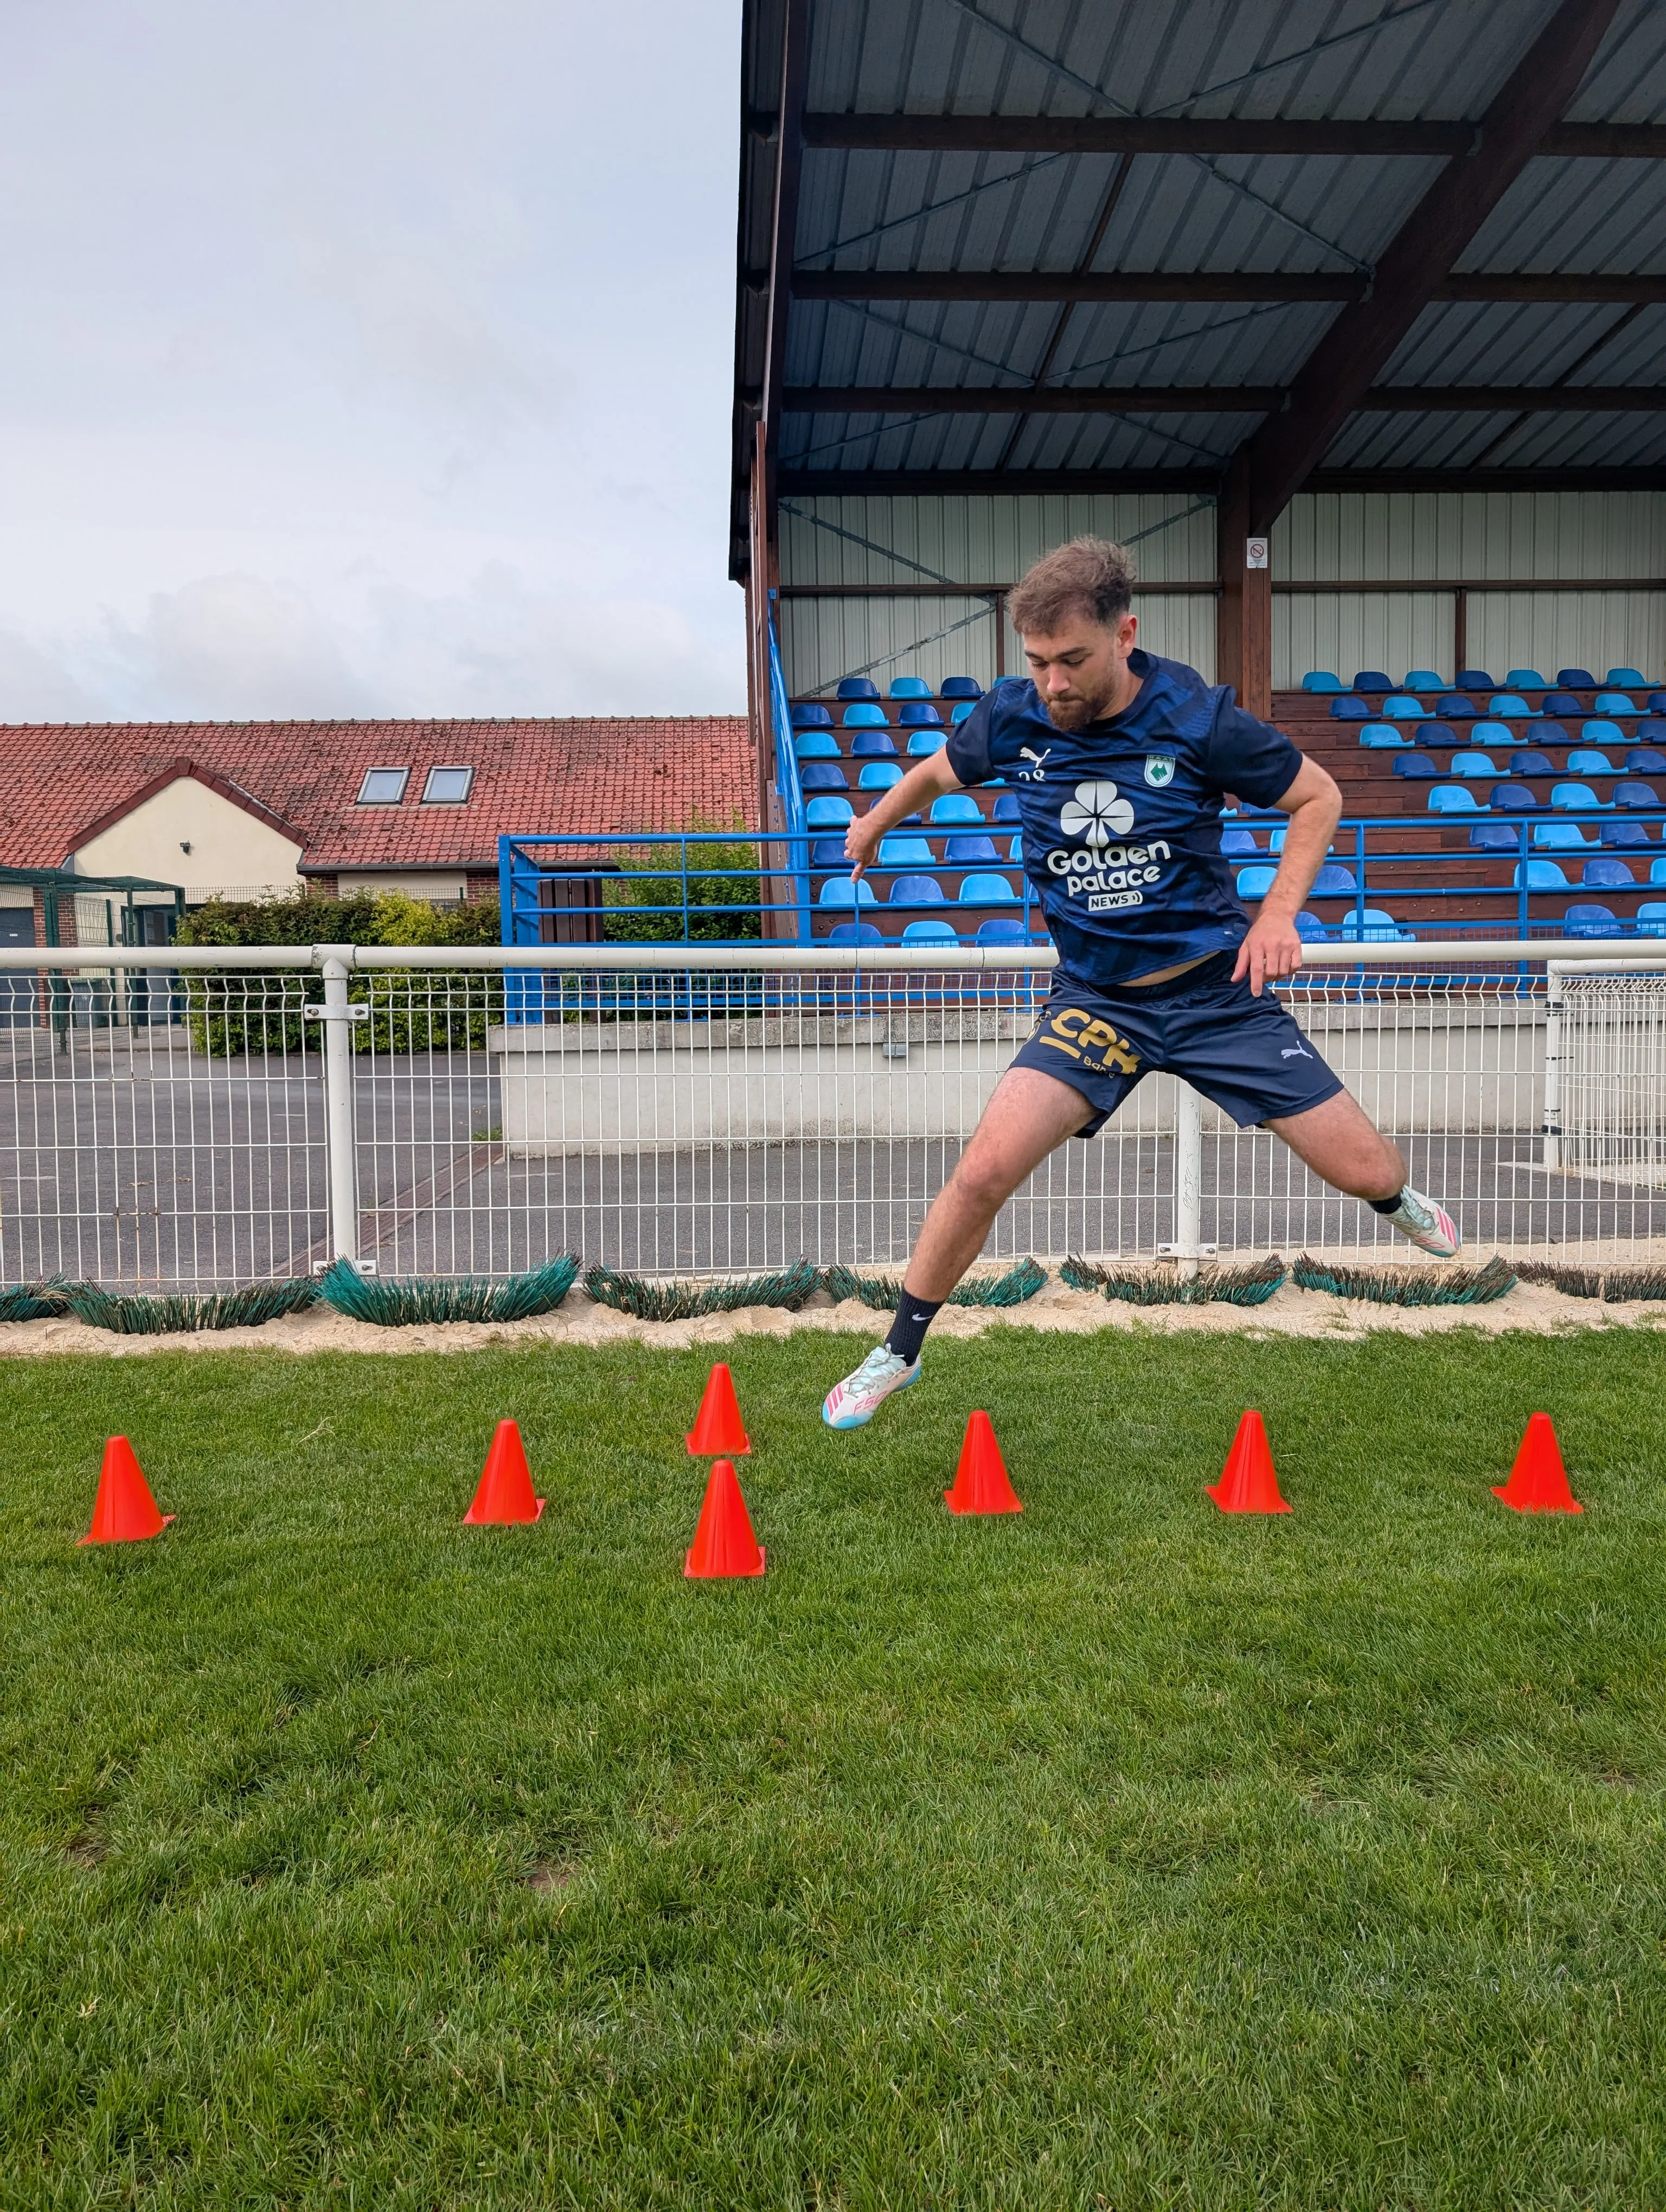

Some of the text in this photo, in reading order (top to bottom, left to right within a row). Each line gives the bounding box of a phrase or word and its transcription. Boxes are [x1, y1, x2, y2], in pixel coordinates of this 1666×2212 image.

[1066, 865, 1161, 897] palace
[1091, 894, 1129, 909] NEWS
[853, 1390, 887, 1416] F50
